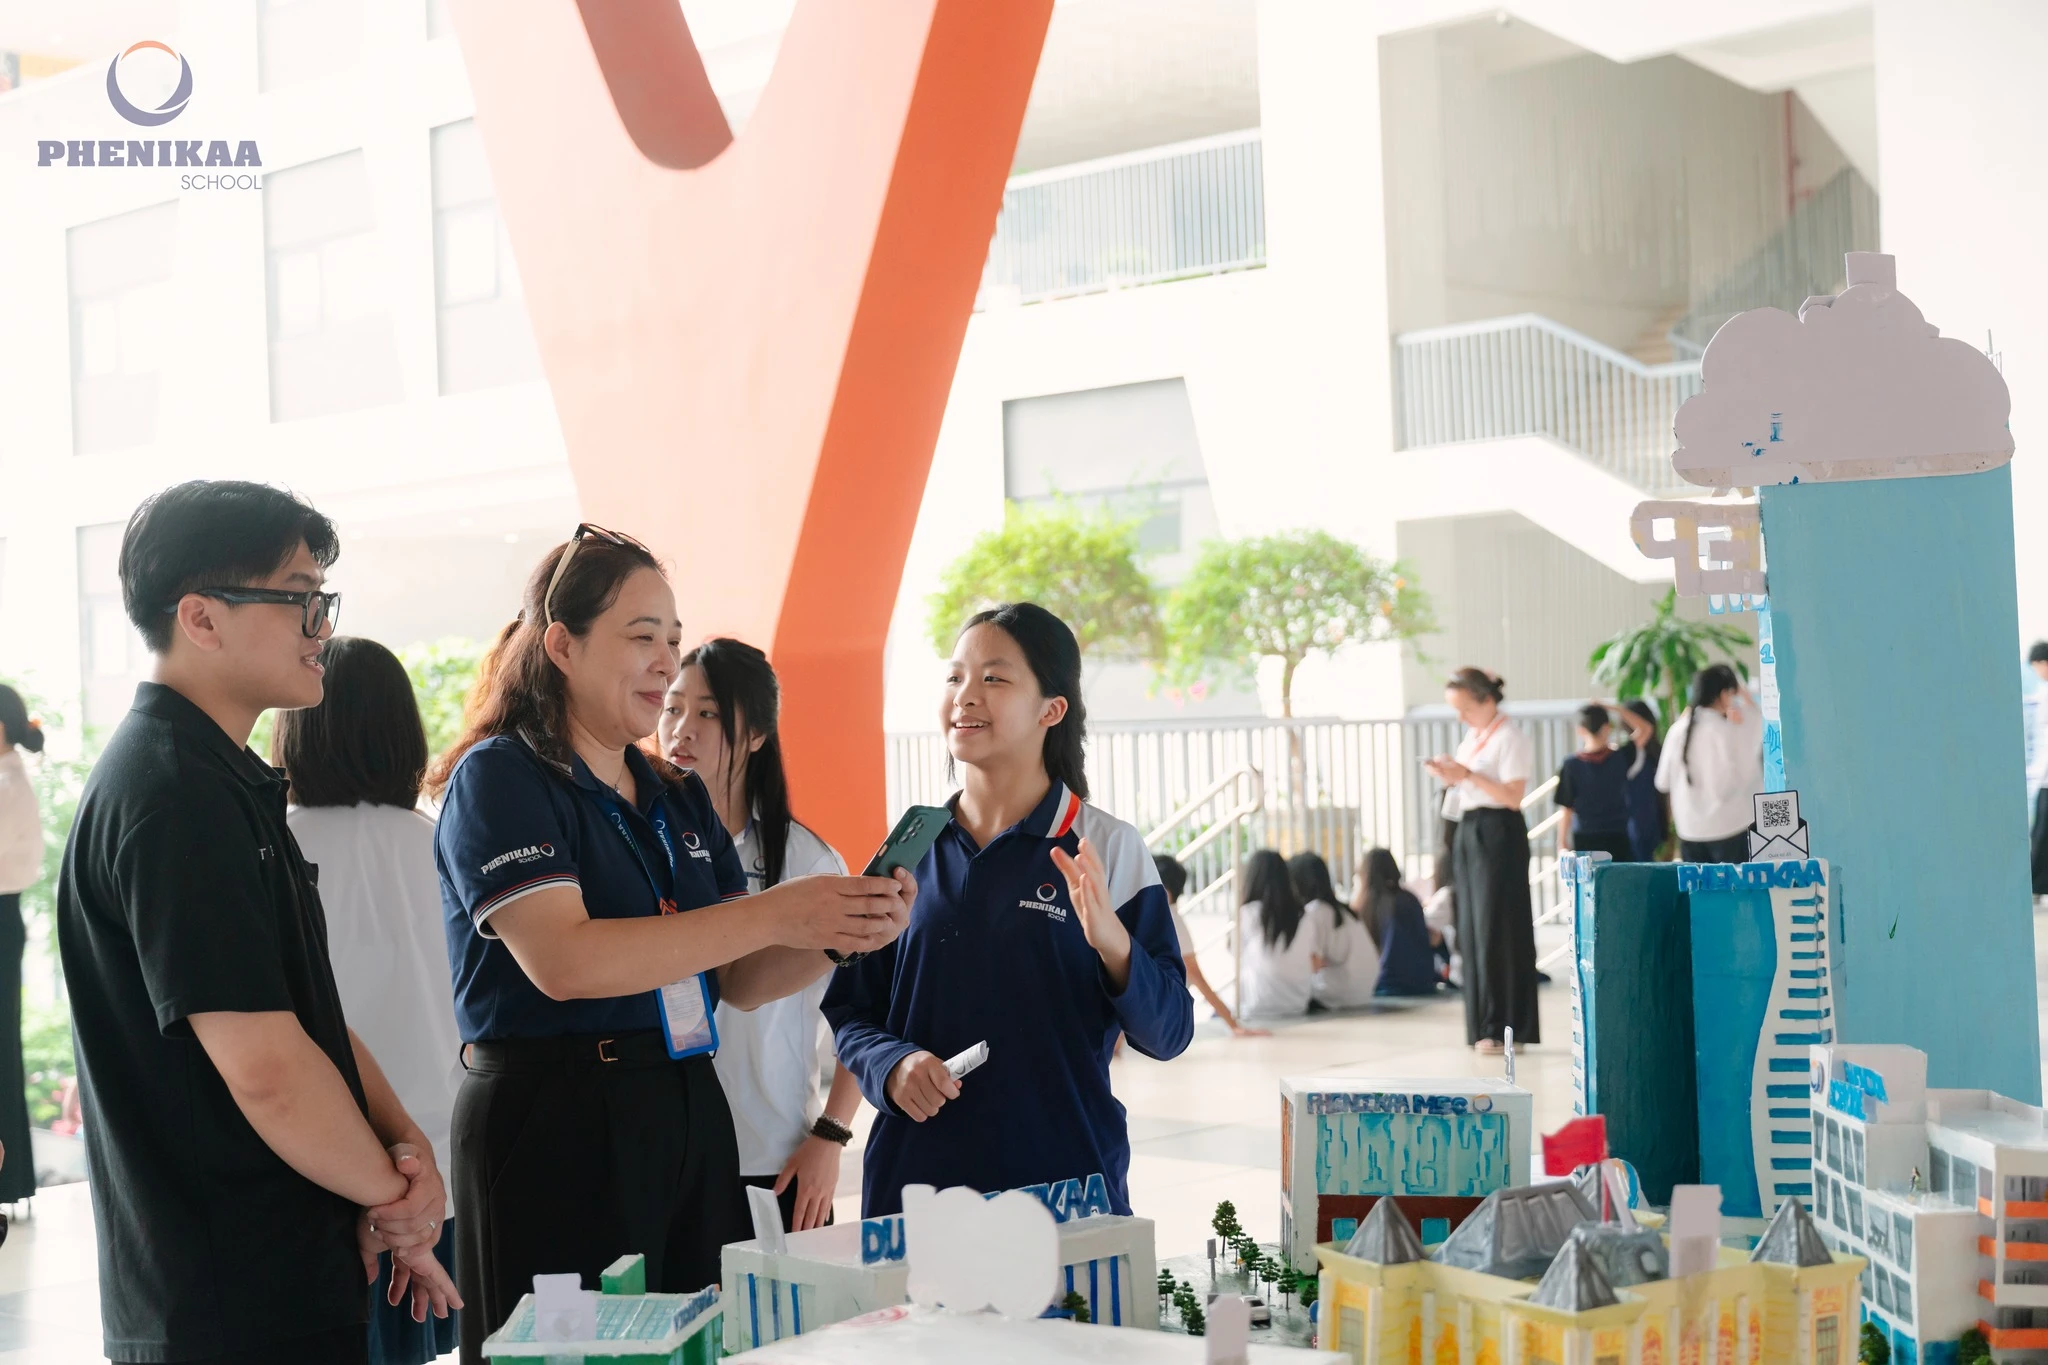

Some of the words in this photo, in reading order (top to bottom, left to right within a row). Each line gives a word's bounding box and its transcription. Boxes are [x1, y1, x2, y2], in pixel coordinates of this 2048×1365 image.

[481, 845, 540, 875] PHENIKAA
[518, 853, 542, 864] SCHOOL
[1677, 859, 1826, 892] PHENIKAA
[1019, 900, 1067, 918] PHENIKAA
[1047, 912, 1066, 923] SCHOOL
